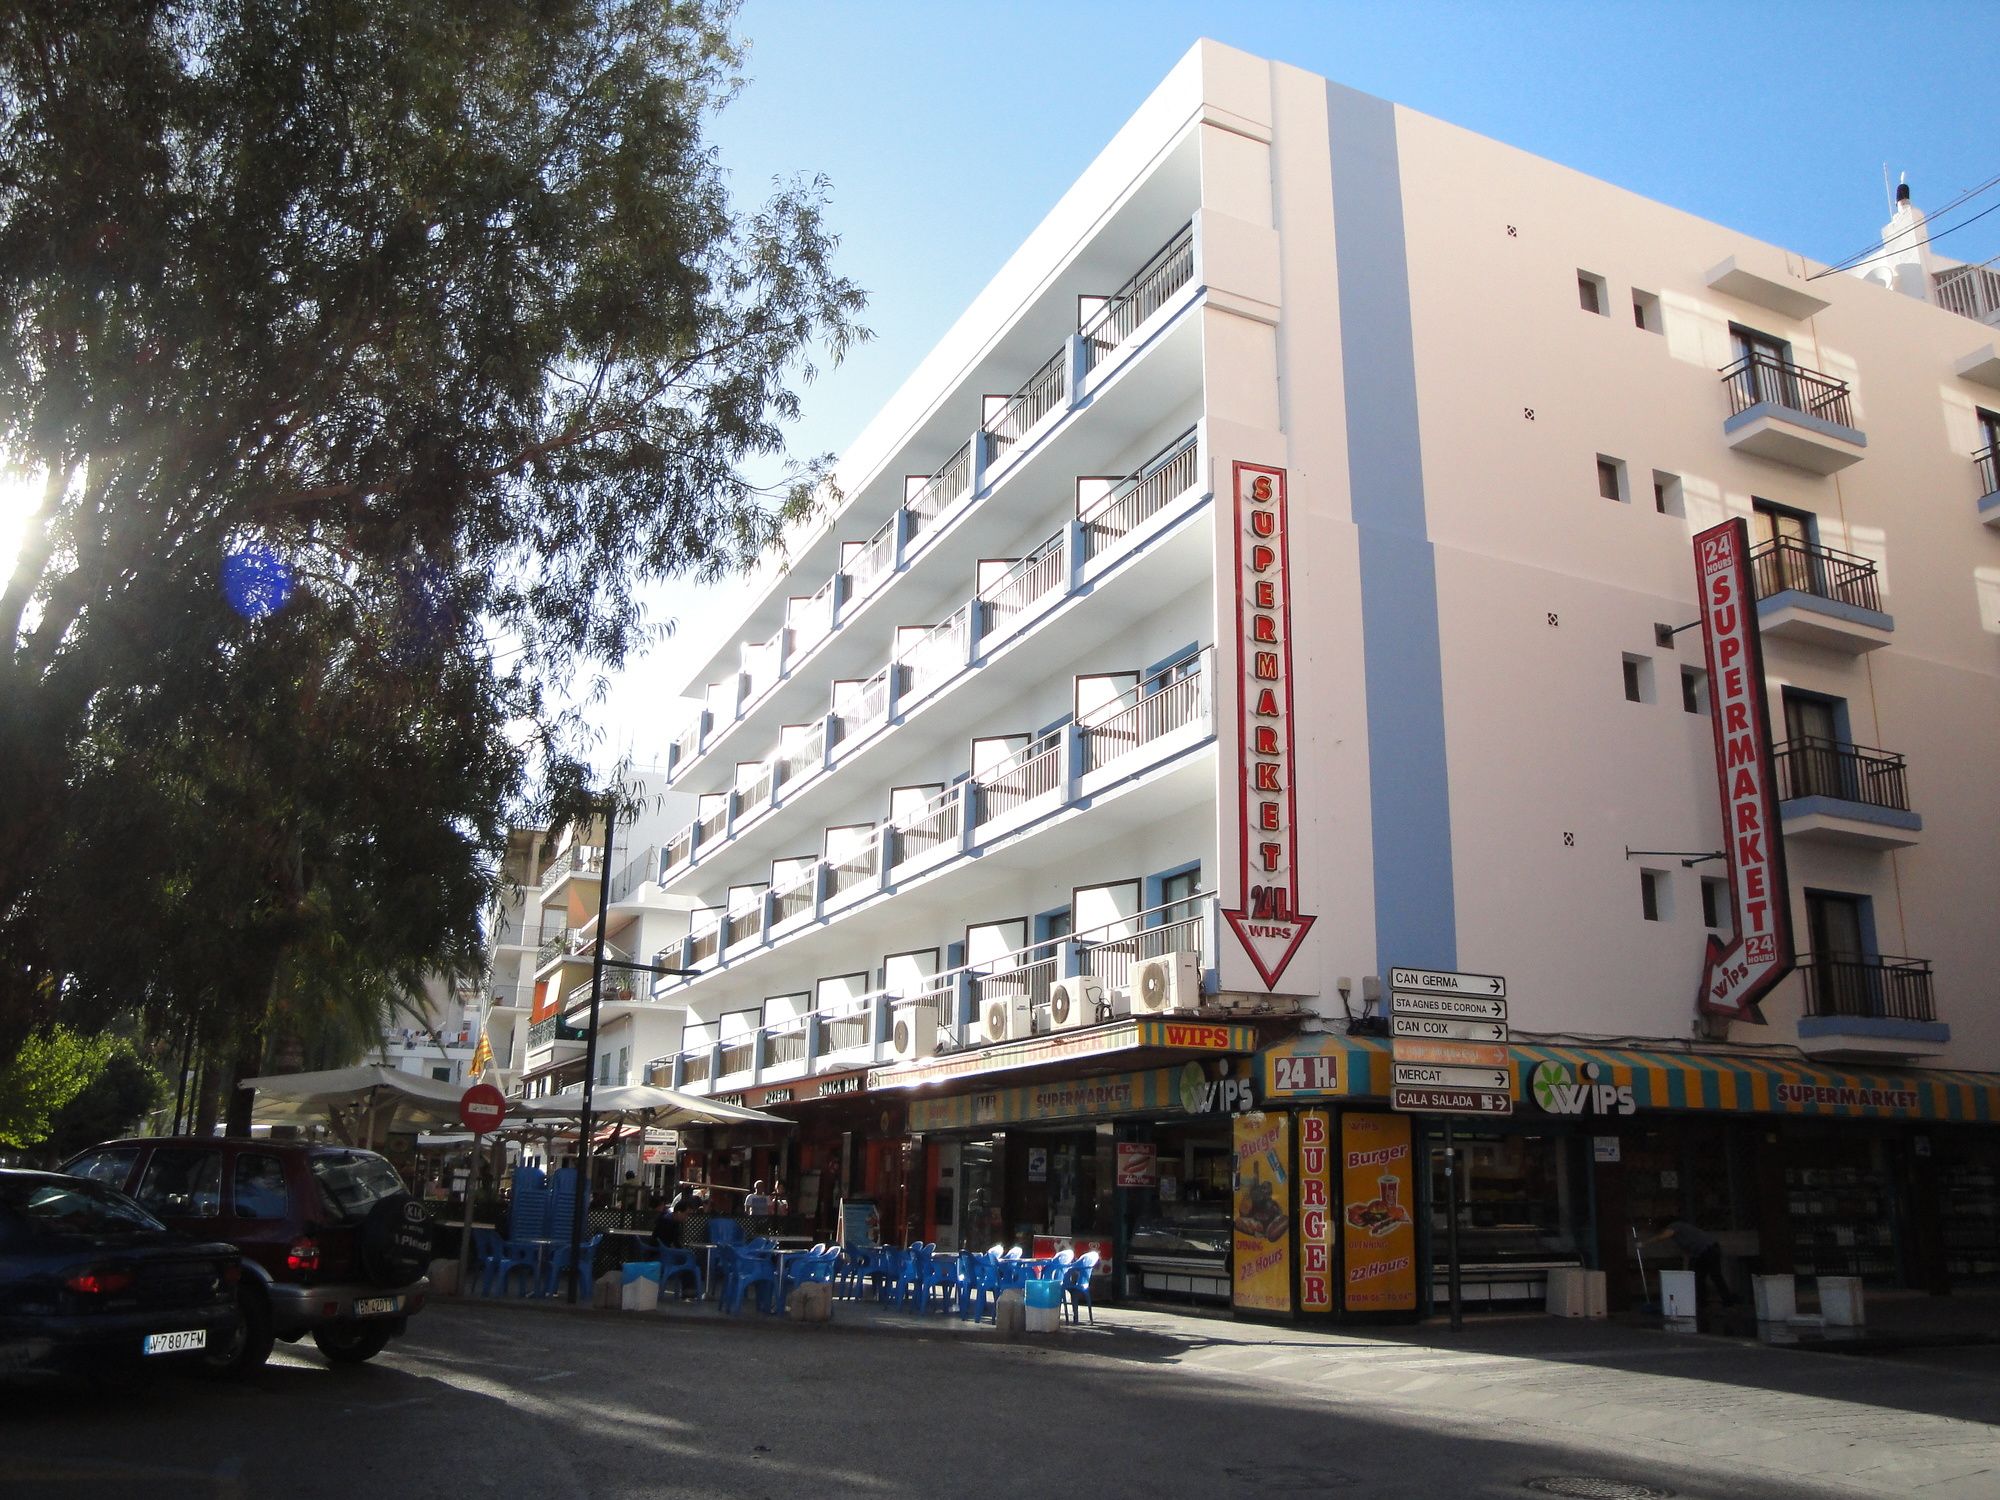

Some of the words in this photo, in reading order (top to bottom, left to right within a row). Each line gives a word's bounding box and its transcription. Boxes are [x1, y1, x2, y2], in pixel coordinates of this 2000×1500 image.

[1705, 535, 1730, 563] 24
[1707, 557, 1732, 574] HOURS
[1251, 475, 1281, 873] SUPERMARKET
[1712, 575, 1768, 933] SUPERMARKET
[1248, 925, 1291, 939] WIPS
[1747, 936, 1773, 955] 24
[1748, 953, 1774, 963] HOURS
[1395, 973, 1418, 985] CAN
[1422, 975, 1459, 988] GERMA
[1396, 998, 1411, 1007] STA
[1413, 1000, 1440, 1010] AGNES
[1441, 1002, 1452, 1010] DE
[1454, 1003, 1487, 1013] CORONA
[1166, 1025, 1229, 1047] WIPS
[1396, 1020, 1420, 1032] CAN
[1424, 1022, 1448, 1034] COIX
[1277, 1058, 1306, 1088] 24
[1398, 1068, 1441, 1081] MERCAT
[765, 1088, 792, 1105] PIZZERIA
[818, 1080, 843, 1096] SNACK
[844, 1076, 859, 1093] BAR
[1036, 1084, 1131, 1109] SUPERMARKET
[1777, 1083, 1918, 1107] SUPERMARKET
[1398, 1093, 1428, 1105] CALA
[1431, 1094, 1474, 1107] SALADA
[1240, 1126, 1281, 1160] Burger
[1348, 1144, 1408, 1168] Burger
[407, 1205, 423, 1219] KIA
[1303, 1117, 1328, 1305] BURGER
[1256, 1248, 1283, 1272] Hours
[1350, 1266, 1367, 1283] 22
[1368, 1257, 1409, 1277] Hours
